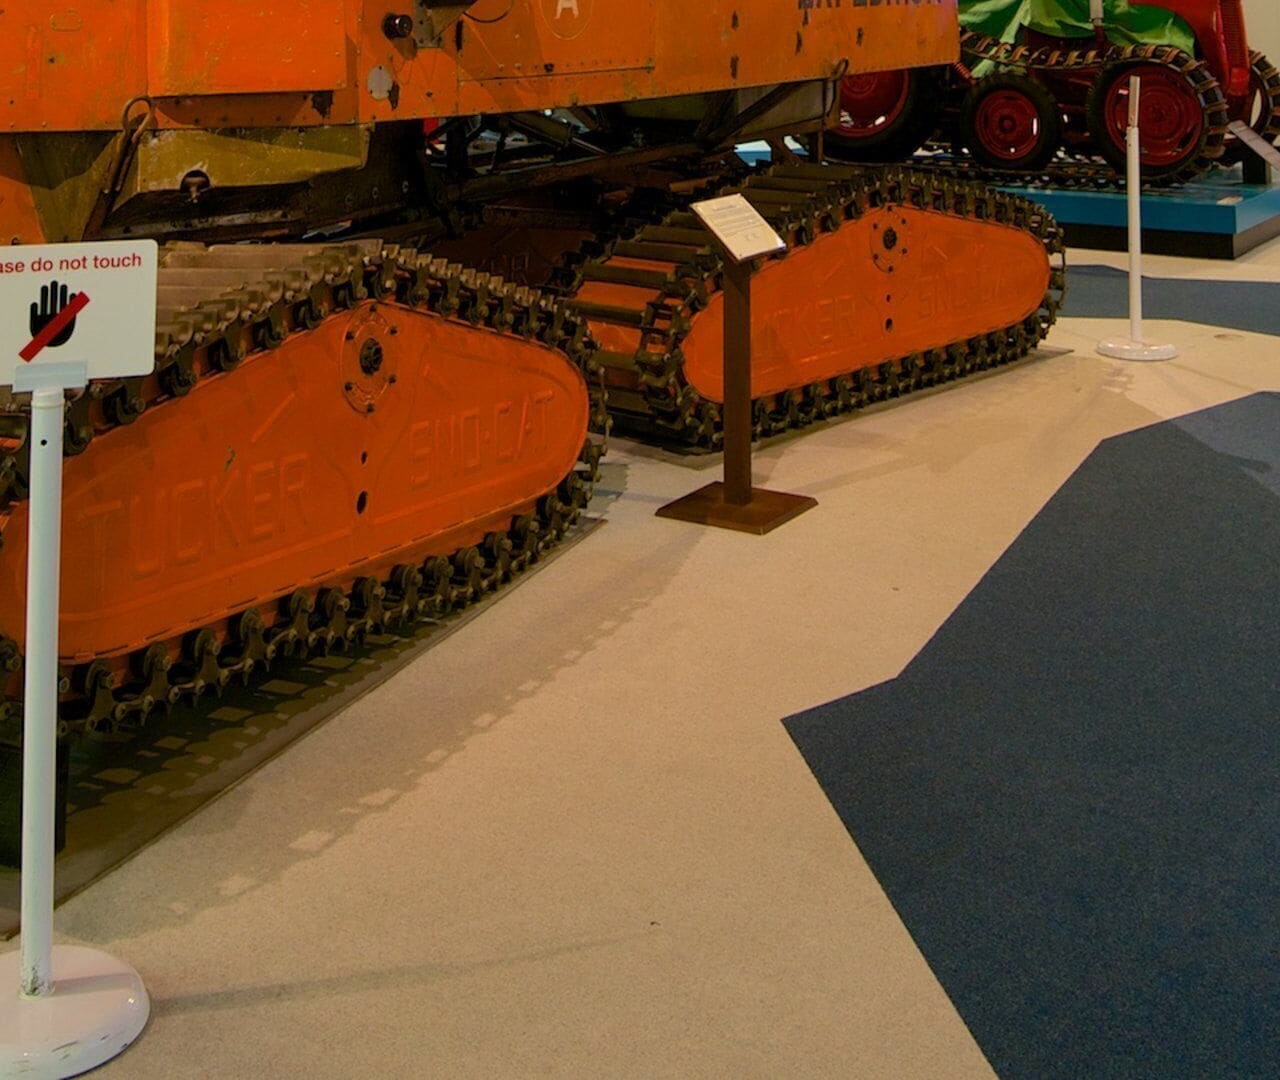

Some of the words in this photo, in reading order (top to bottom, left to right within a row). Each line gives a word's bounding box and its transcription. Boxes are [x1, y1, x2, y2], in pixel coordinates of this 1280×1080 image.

[31, 257, 53, 272] do
[59, 255, 88, 270] not
[94, 252, 142, 269] touch
